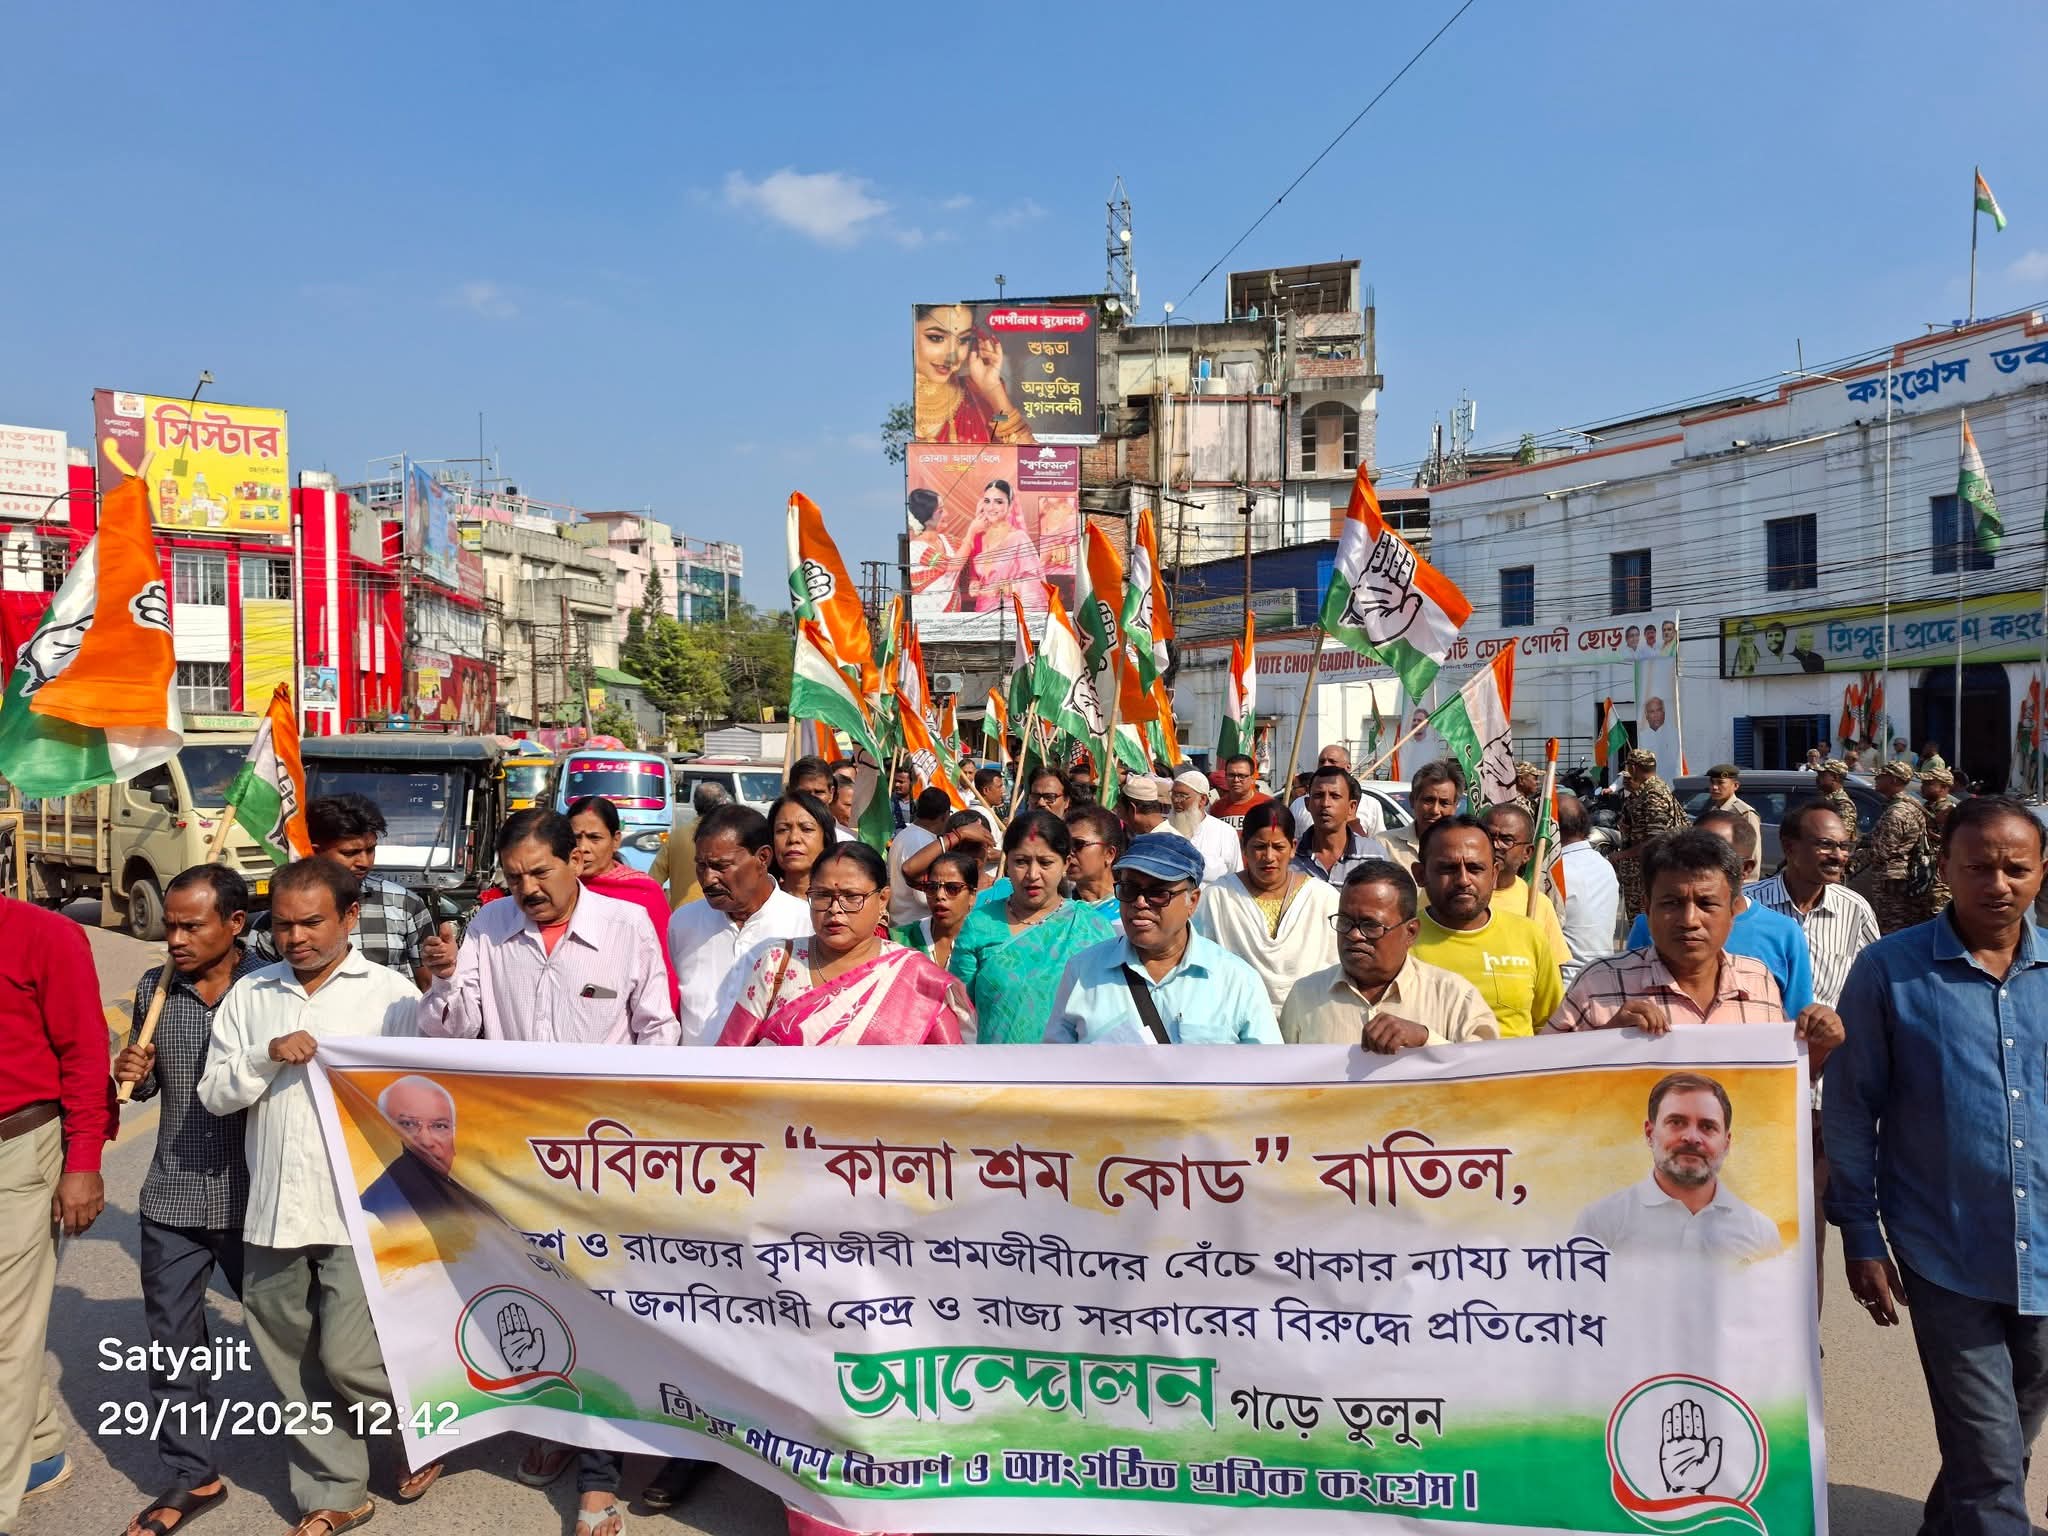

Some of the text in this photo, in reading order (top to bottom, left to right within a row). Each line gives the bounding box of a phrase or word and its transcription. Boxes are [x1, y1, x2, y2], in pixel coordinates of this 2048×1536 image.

[1027, 340, 1069, 356] শুদ্ধতা
[1042, 361, 1055, 374] ও
[1021, 377, 1081, 399] অনুভূতির
[1845, 358, 1970, 406] কংগ্রেস
[1023, 397, 1083, 418] যুগলবন্দী
[152, 404, 281, 458] সিস্টার
[1256, 655, 1282, 674] VOTE
[1319, 650, 1355, 671] GADDI
[1522, 626, 1570, 656] গোদী
[1577, 626, 1624, 652] ছোড়
[1827, 620, 1896, 660] ত্রিপুরা
[529, 1119, 1527, 1211] অবিলম্বে “কালা শ্রম কোড” বাতিল,
[577, 1233, 609, 1258] ও
[618, 1233, 744, 1270] রাজ্যের
[753, 1231, 915, 1282] কৃষিজীবী
[924, 1231, 1149, 1282] শ্রমজীবীদের
[1165, 1240, 1260, 1279] বেঁচে
[1274, 1247, 1398, 1283] থাকার
[1408, 1244, 1511, 1281] ন্যায্য
[1521, 1236, 1612, 1283] দাবি
[625, 1283, 811, 1330] জনবিরোধী
[827, 1296, 917, 1332] কেন্দ্র
[928, 1297, 962, 1322] ও
[973, 1296, 1064, 1333] রাজ্য
[1074, 1302, 1260, 1340] সরকারের
[1270, 1296, 1413, 1347] বিরুদ্ধে
[1428, 1299, 1608, 1348] প্রতিরোধ
[834, 1345, 1446, 1450] আন্দোলন গড়ে তুলুন
[965, 1453, 989, 1483] ও
[1002, 1447, 1178, 1489] অসংগঠিত
[1188, 1457, 1307, 1497] শ্রমিক
